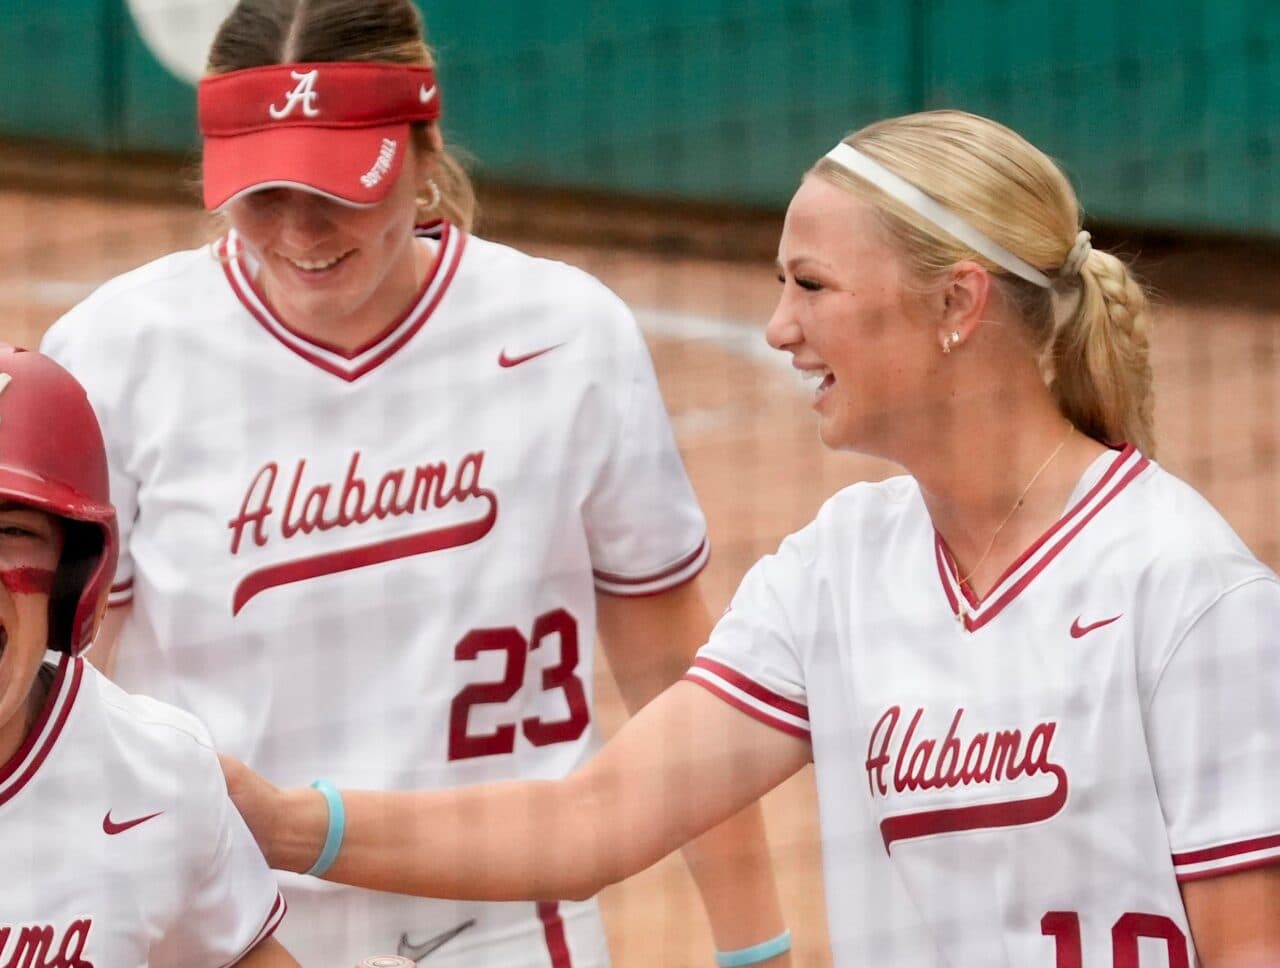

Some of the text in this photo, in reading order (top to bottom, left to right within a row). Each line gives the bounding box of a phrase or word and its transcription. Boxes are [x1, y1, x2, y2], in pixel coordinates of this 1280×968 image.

[269, 69, 320, 119] A
[359, 137, 398, 188] SOFTBALL
[228, 450, 492, 555] Alabama
[448, 607, 591, 762] 23
[865, 704, 1062, 798] Alabama
